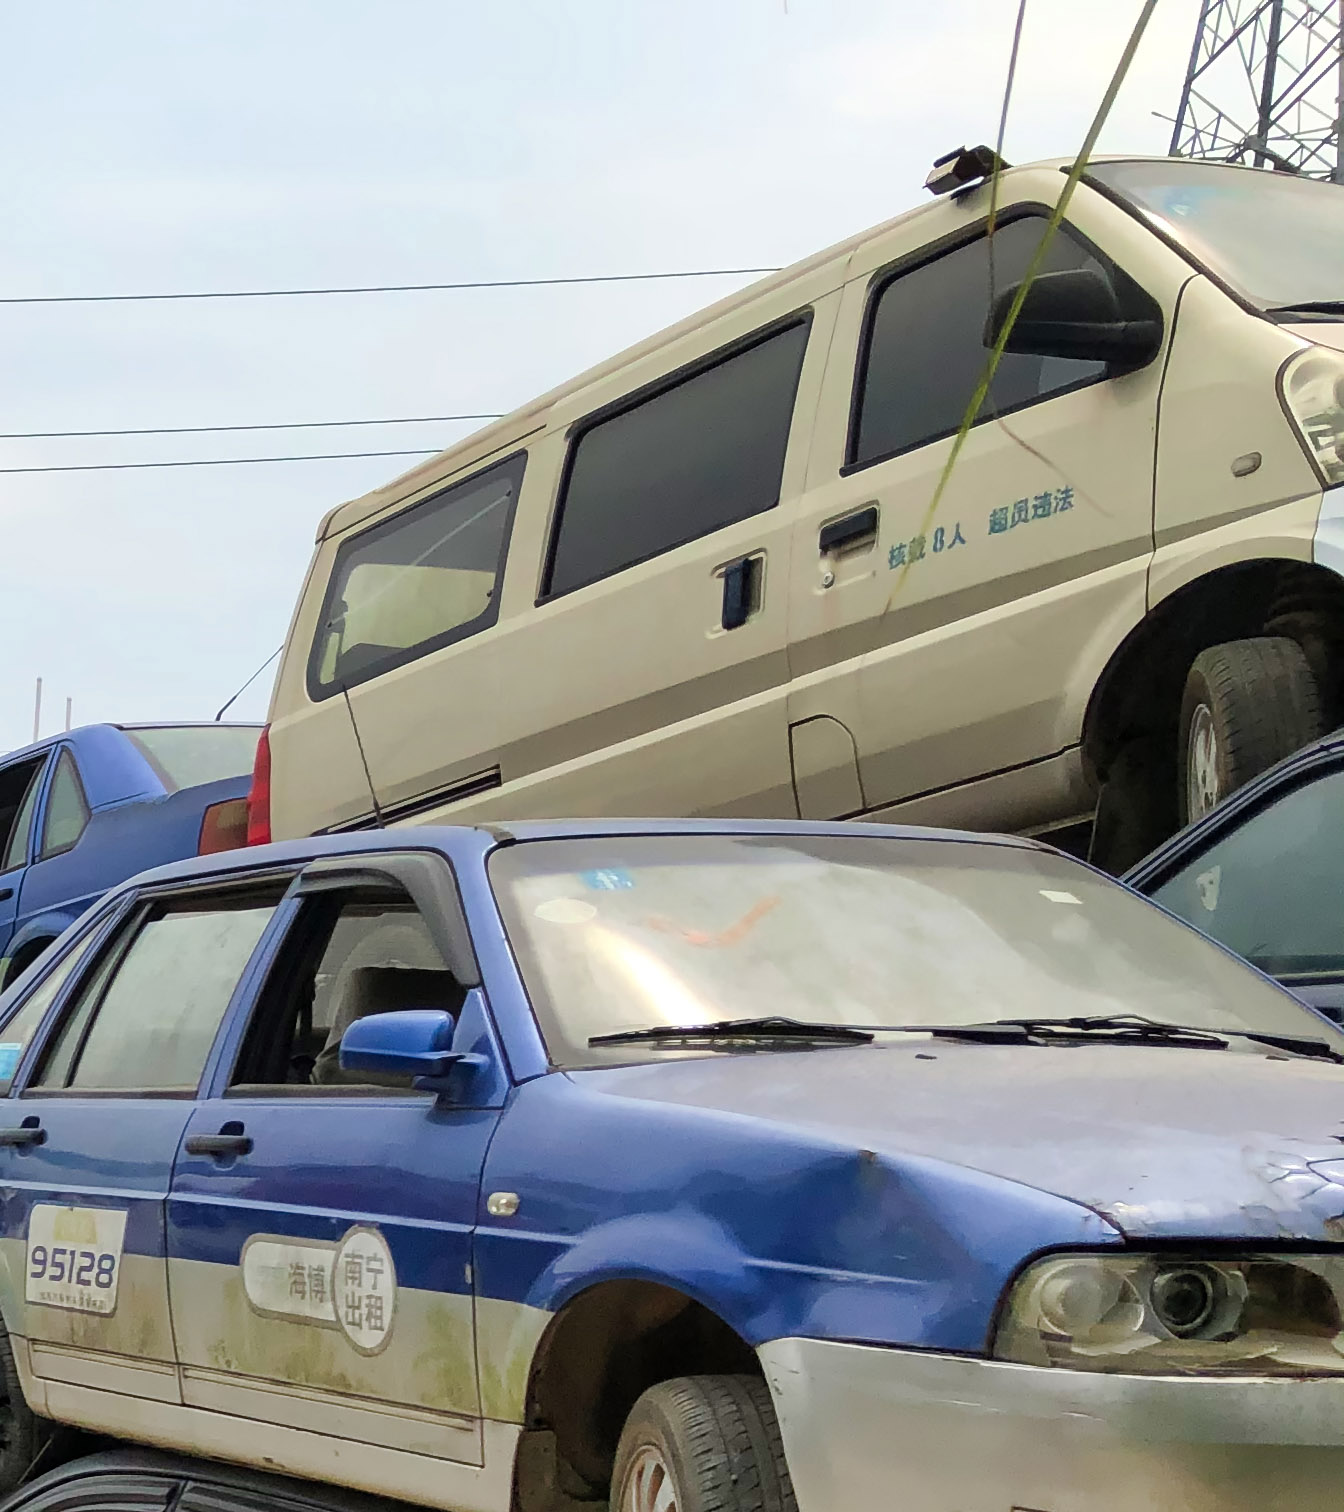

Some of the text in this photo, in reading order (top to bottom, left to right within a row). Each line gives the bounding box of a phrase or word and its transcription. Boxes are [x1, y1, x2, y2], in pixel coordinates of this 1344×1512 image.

[988, 485, 1075, 536] 超员违法
[30, 1245, 116, 1289] 95128
[344, 1250, 385, 1291] 南宁
[344, 1291, 385, 1332] 出租
